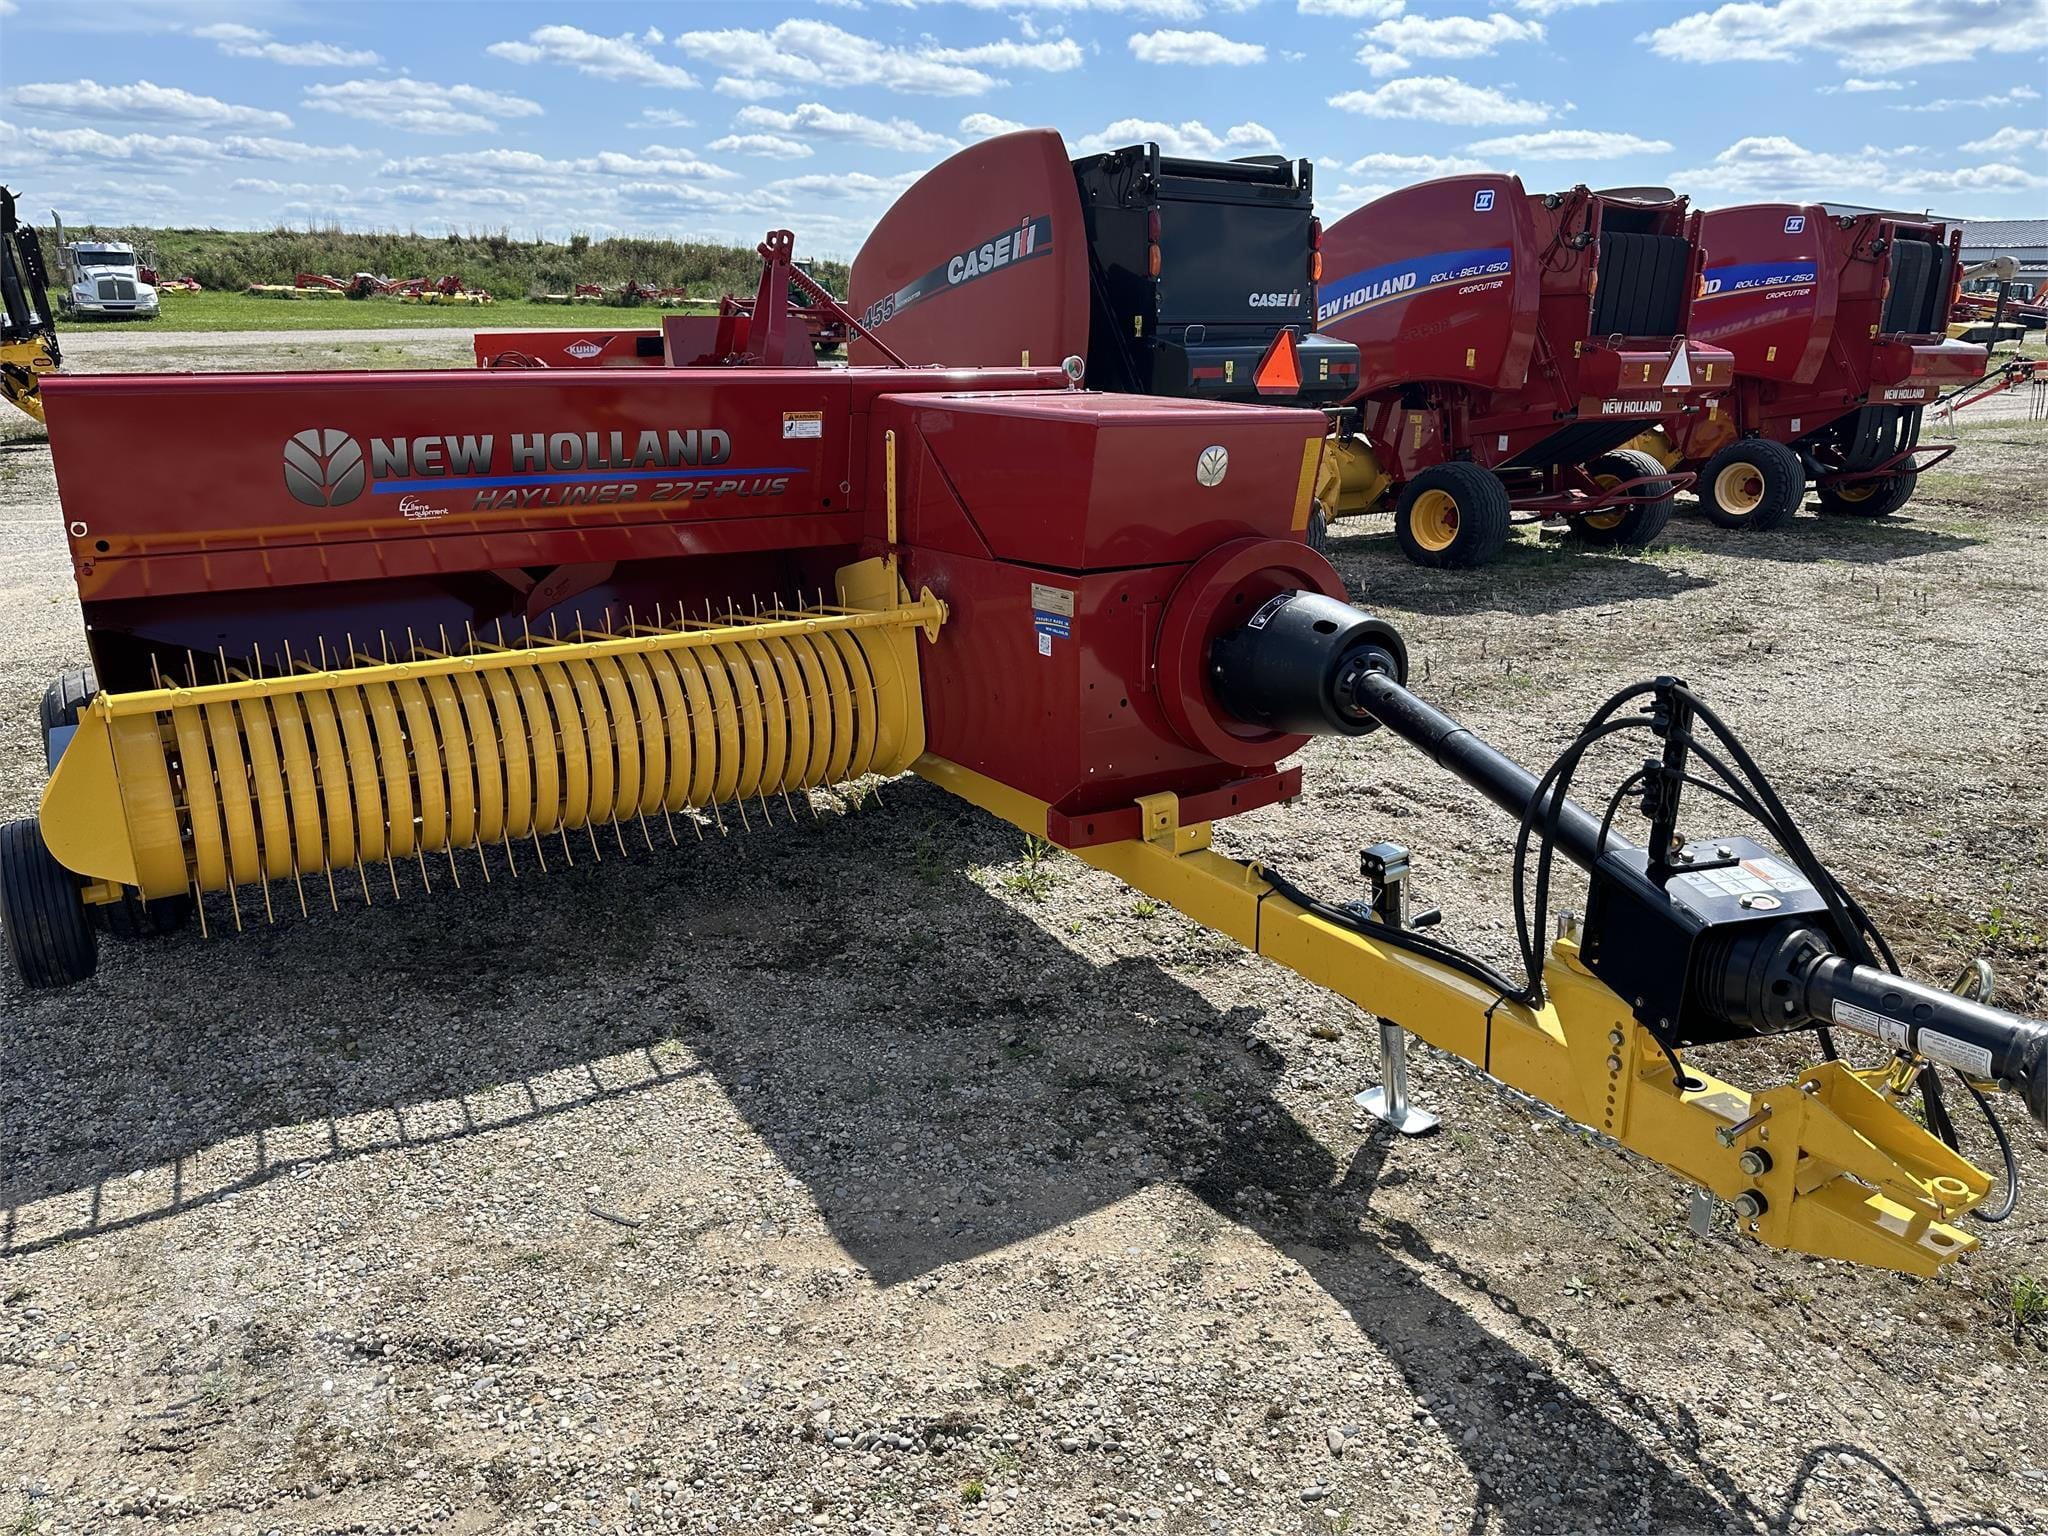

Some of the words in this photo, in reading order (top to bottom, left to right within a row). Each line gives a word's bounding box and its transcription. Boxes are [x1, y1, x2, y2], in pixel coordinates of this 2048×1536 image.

[947, 235, 1011, 284] CASE
[1458, 280, 1503, 295] CROPCUTTER
[1734, 275, 1791, 290] ROLL-BELT
[1791, 273, 1814, 282] 450
[1317, 297, 1341, 322] EW
[1342, 272, 1417, 311] HOLLAND
[1429, 264, 1485, 284] ROLL-BELT
[1486, 261, 1509, 273] 450
[1765, 288, 1811, 300] CROPCUTTER
[1249, 293, 1287, 307] CASE
[569, 345, 597, 353] KUHN
[1884, 389, 1898, 400] NEW
[1898, 388, 1925, 400] HOLLAND
[1602, 401, 1623, 414] NEW
[1623, 400, 1662, 413] HOLLAND
[369, 434, 495, 479] NEW
[510, 428, 732, 473] HOLLAND
[472, 482, 638, 511] HAYLINER
[404, 500, 449, 517] Equipment
